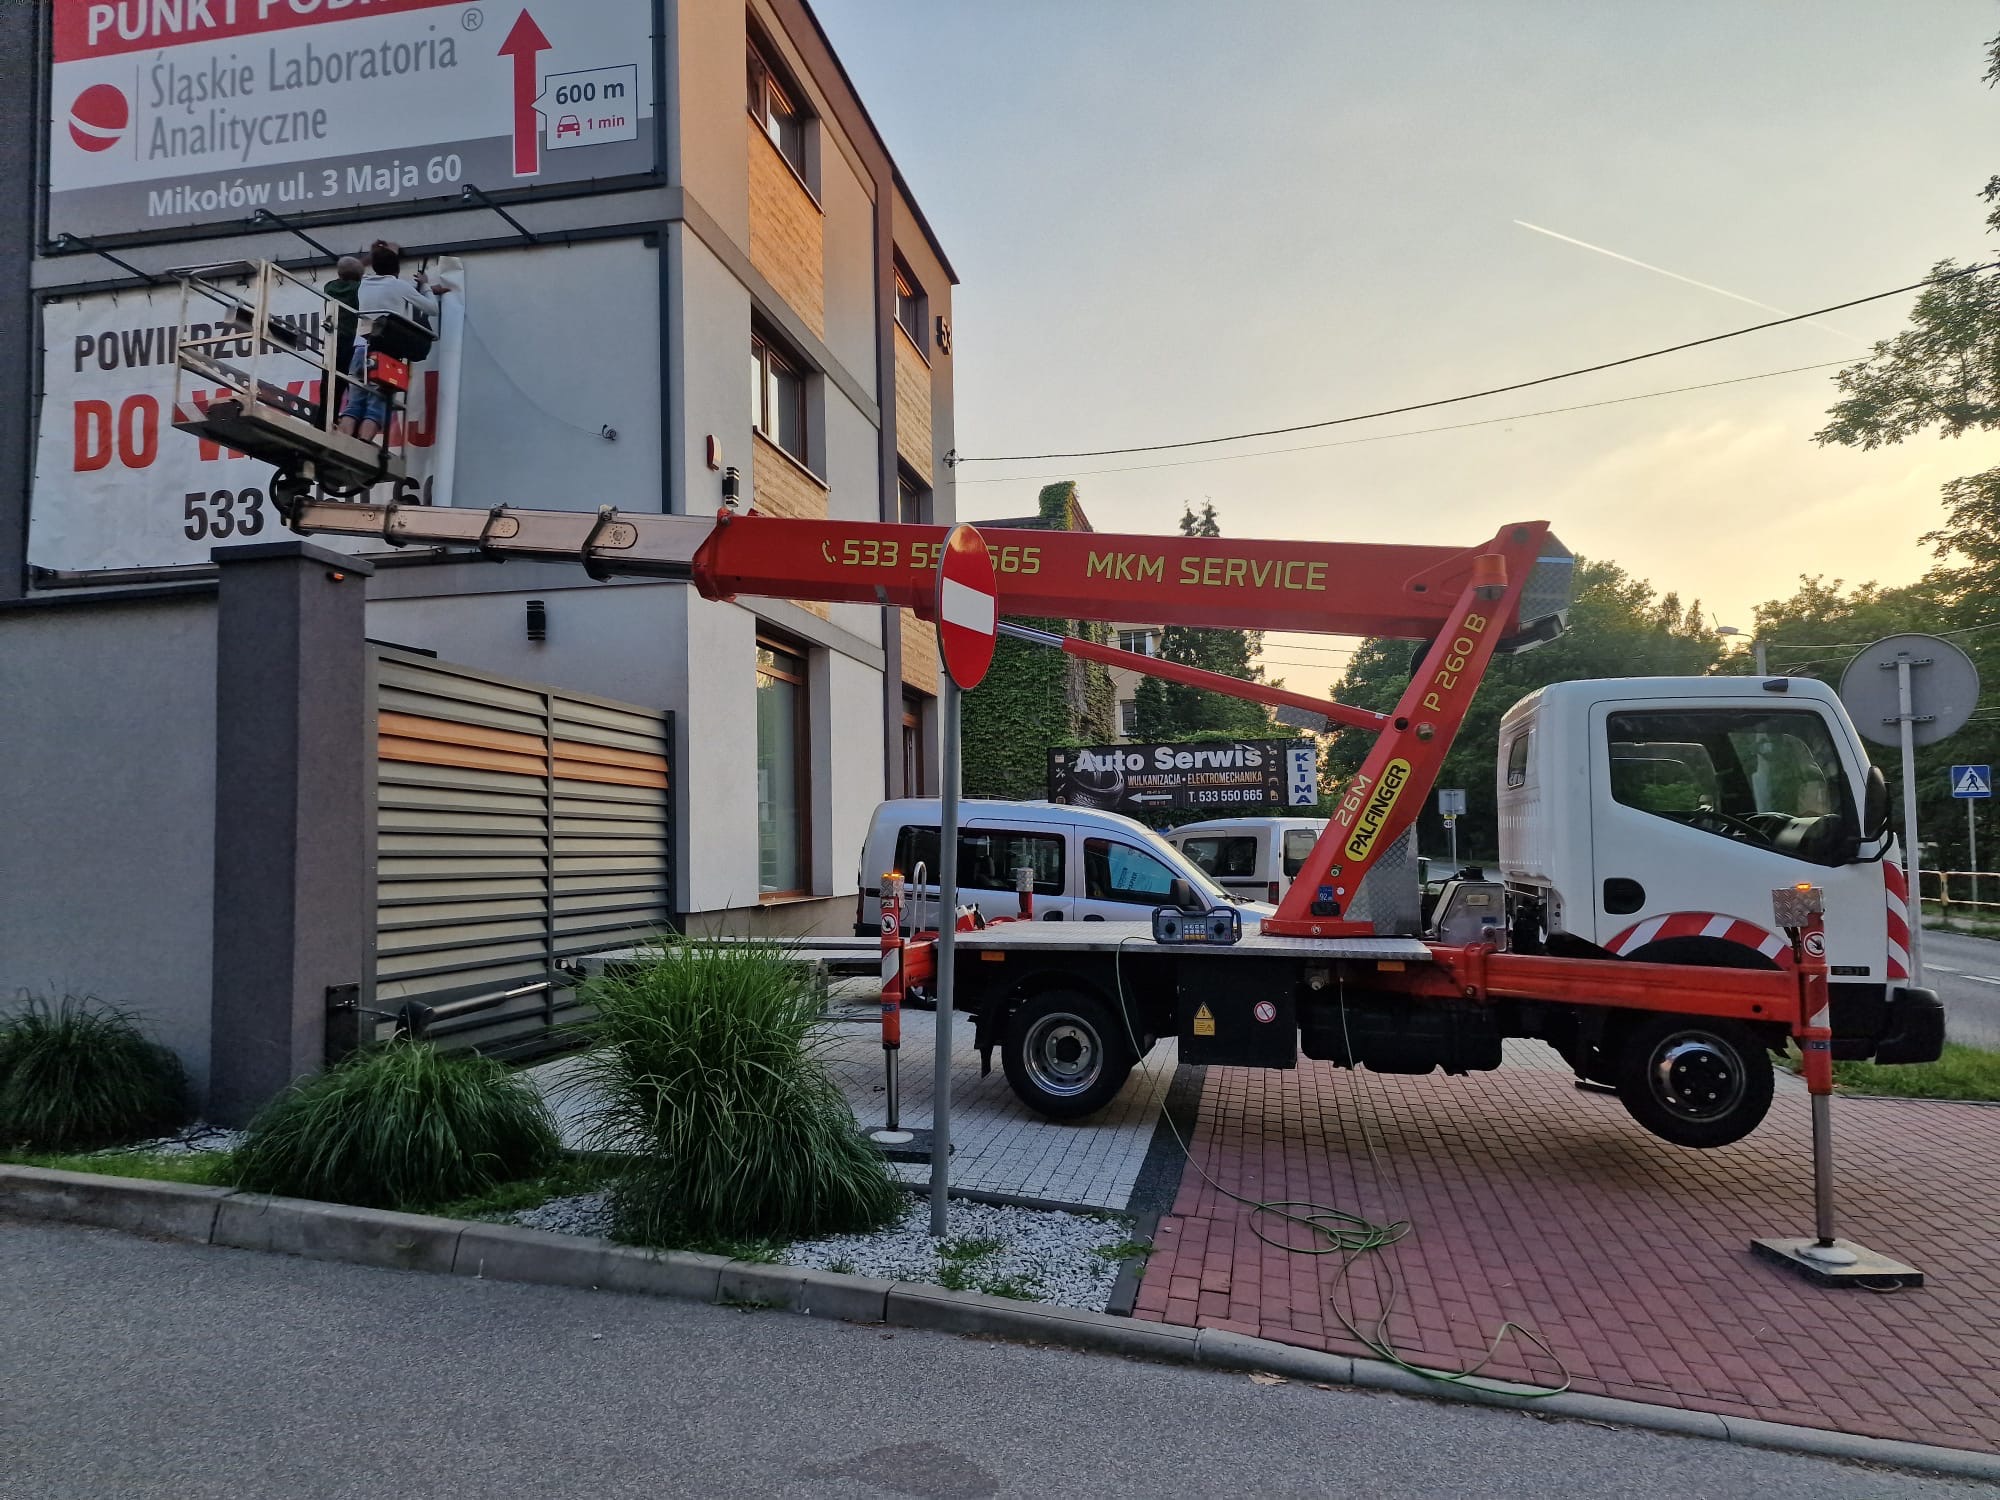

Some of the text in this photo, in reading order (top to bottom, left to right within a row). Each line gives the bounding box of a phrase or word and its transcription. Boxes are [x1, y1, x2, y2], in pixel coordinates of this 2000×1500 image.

[151, 51, 254, 114] Śląskie
[270, 25, 458, 91] Laboratoria
[556, 82, 625, 104] 600 m
[149, 108, 327, 162] Analityczne
[587, 115, 625, 130] 1 min
[148, 154, 462, 217] Mikołów ul. 3 Maja 60
[74, 394, 159, 472] DO
[184, 487, 265, 541] 533
[843, 539, 899, 567] 533
[1087, 551, 1329, 591] MKM SERVICE
[1423, 613, 1487, 712] P 260 B
[1074, 744, 1263, 773] Auto Serwis
[1127, 771, 1263, 786] WULKANIZACJA ELEKTROMECHANIKA
[1295, 752, 1312, 804] KLIMA
[1188, 789, 1263, 803] T. 533 550 665
[1335, 774, 1372, 827] 26M
[1348, 764, 1407, 856] PALFINGER
